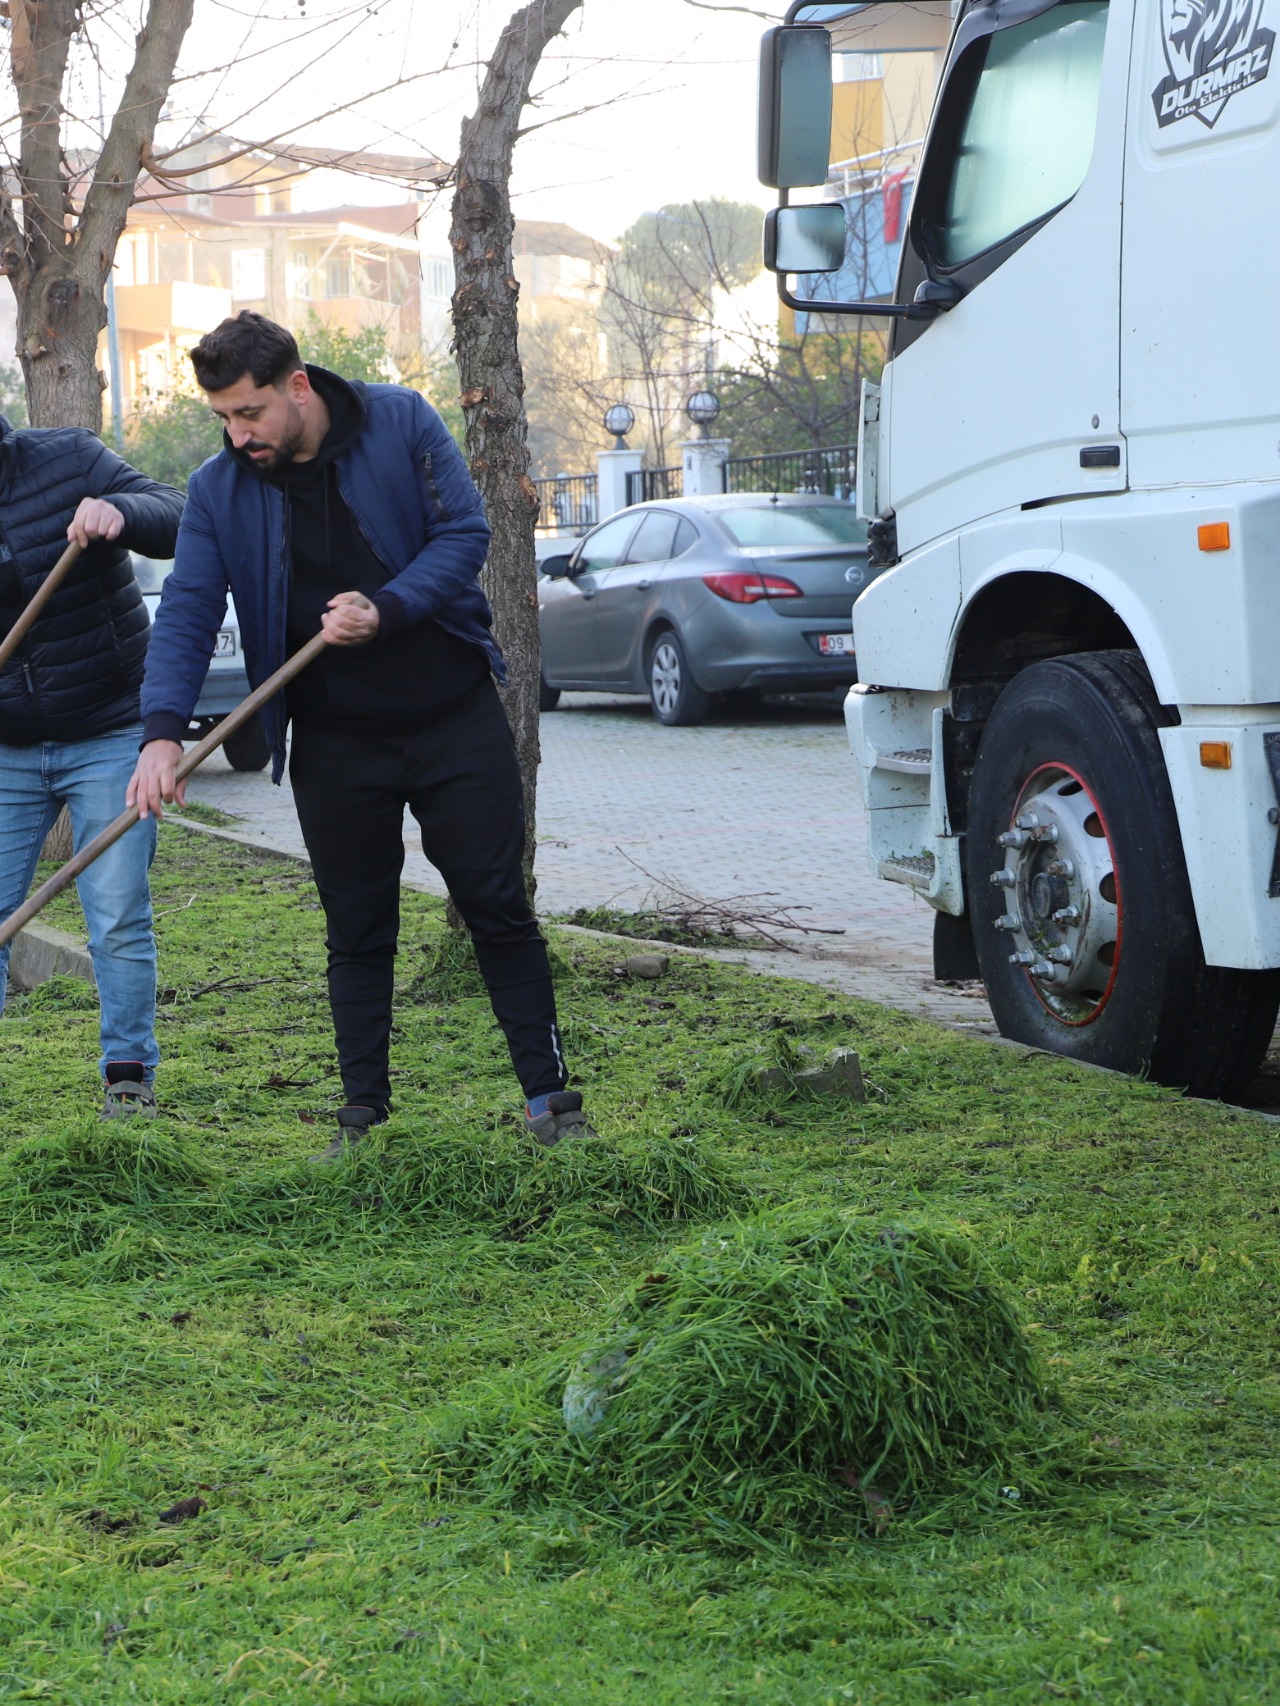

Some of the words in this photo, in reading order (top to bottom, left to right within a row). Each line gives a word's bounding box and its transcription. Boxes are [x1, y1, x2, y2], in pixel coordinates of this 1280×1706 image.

[1160, 44, 1269, 117] DURMAZ
[1174, 105, 1197, 119] Oto
[1199, 74, 1257, 107] Elektirik
[828, 636, 844, 649] 09
